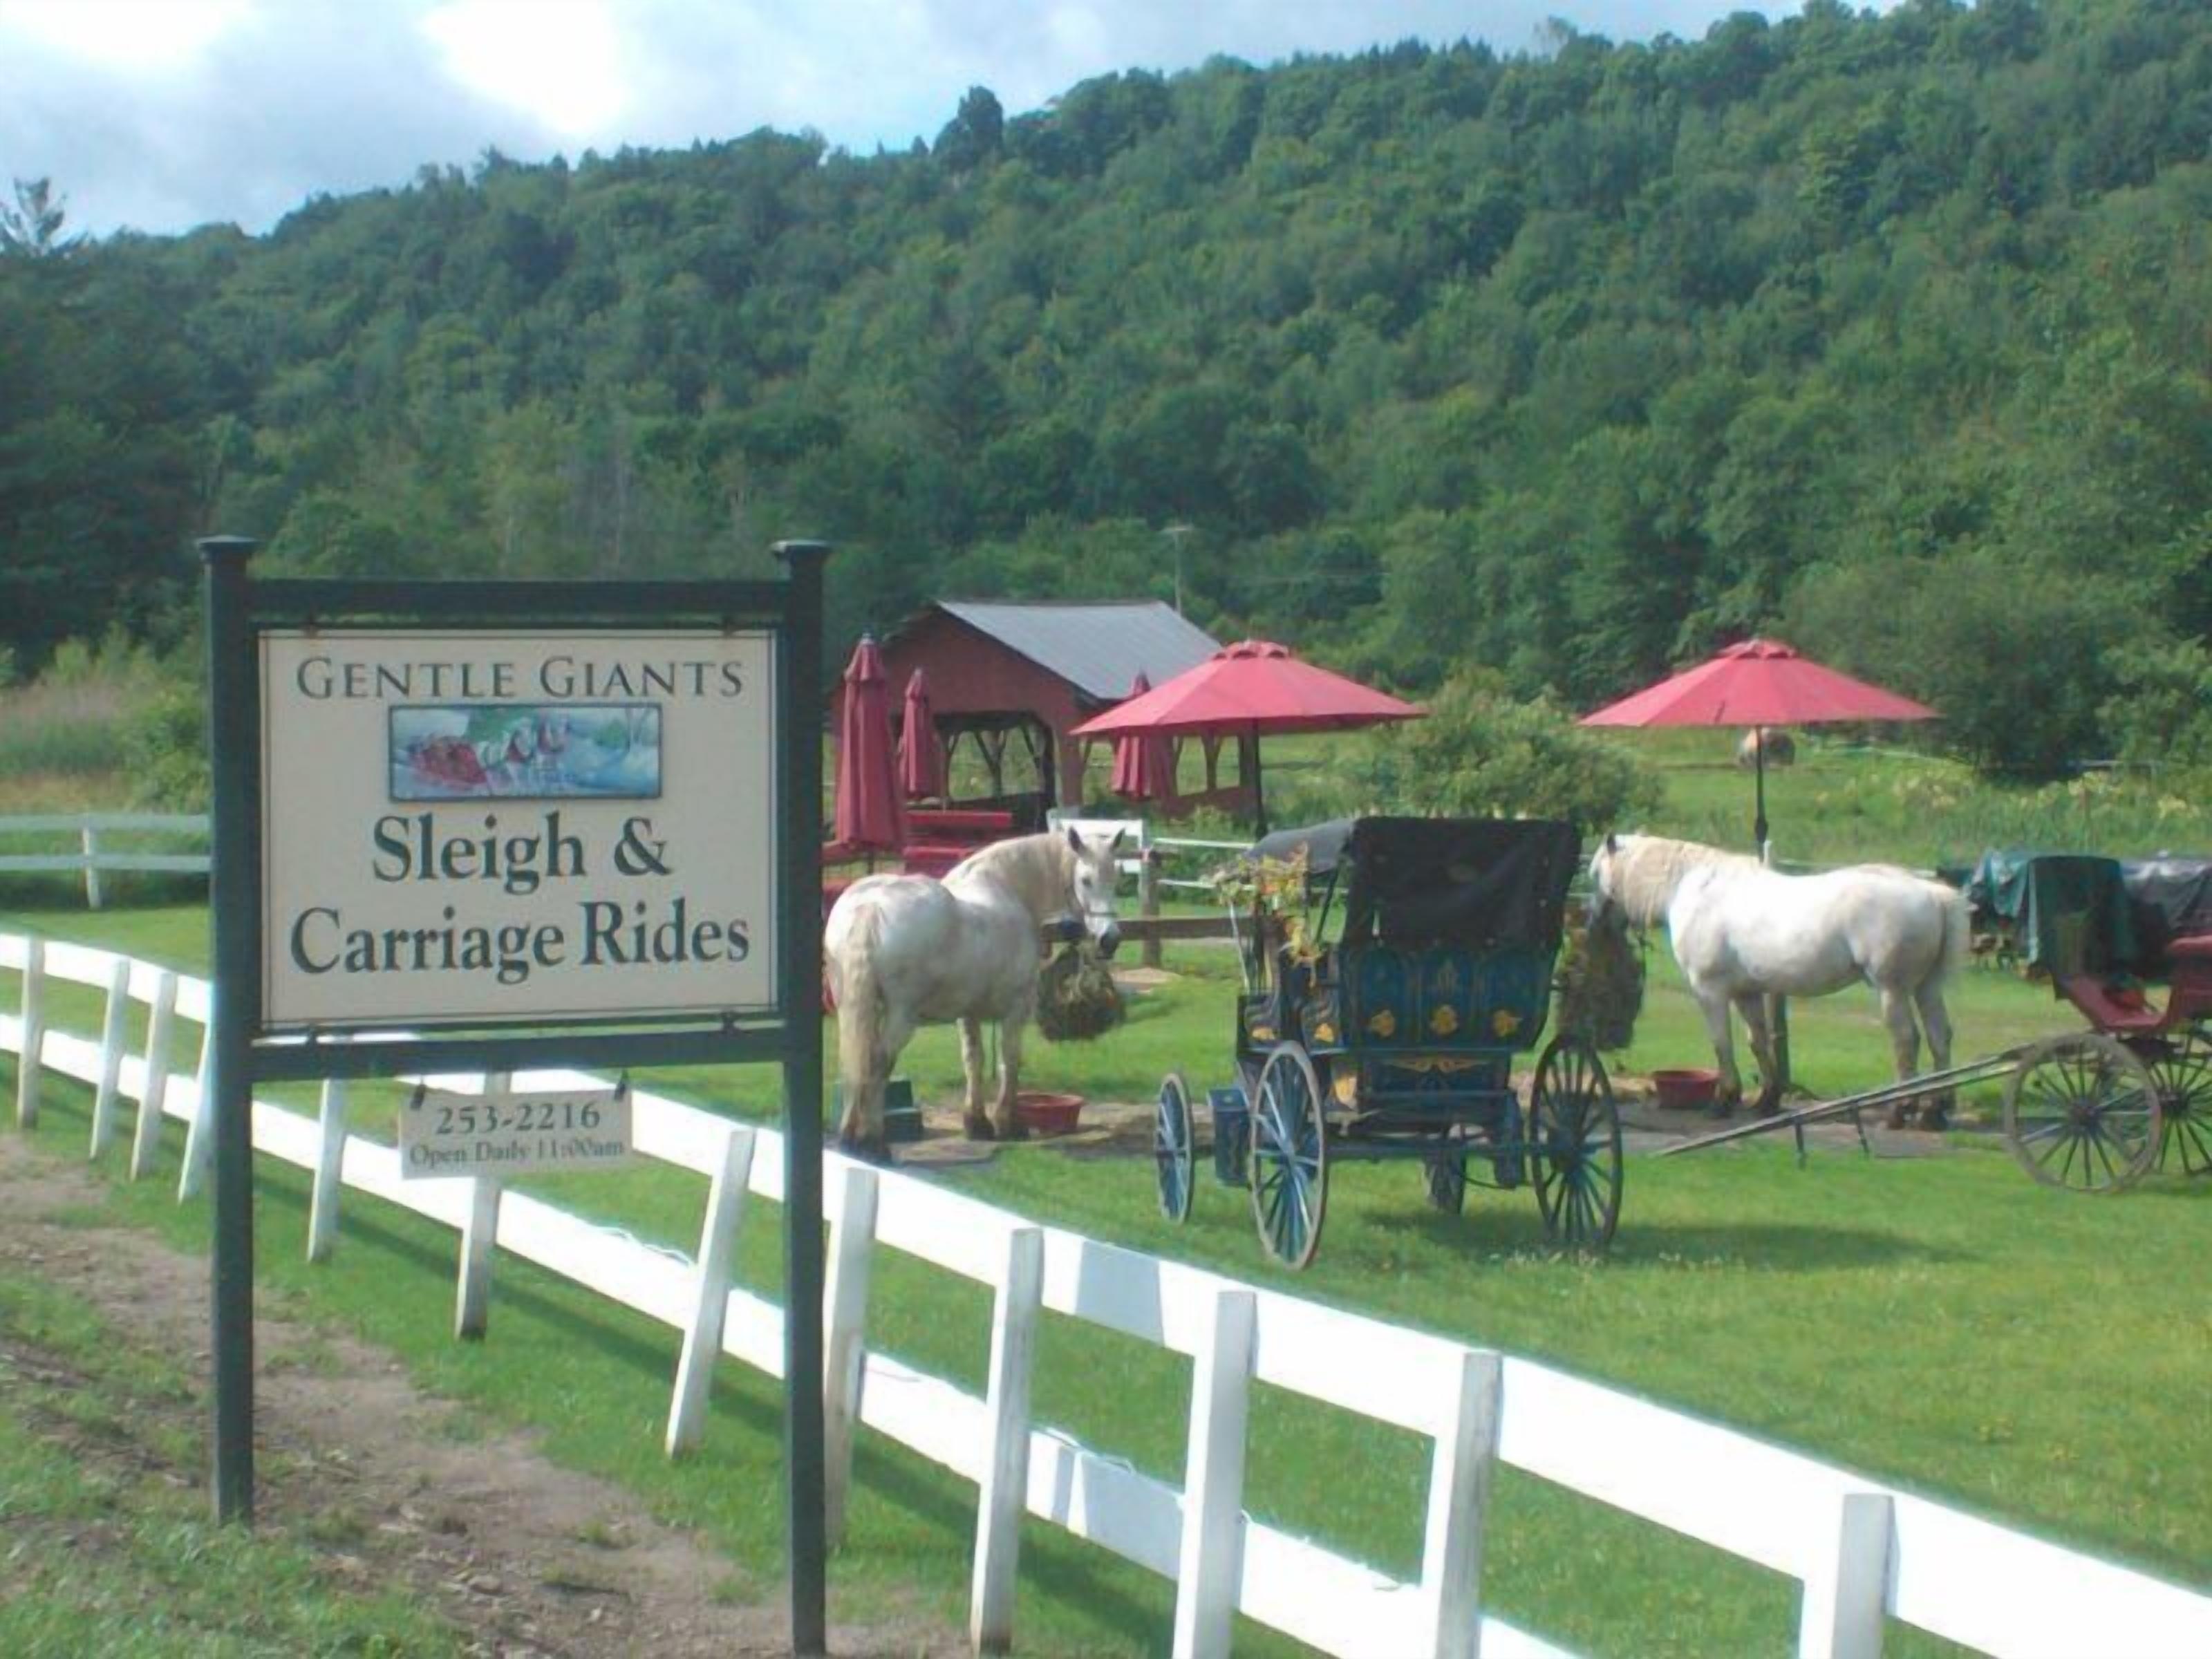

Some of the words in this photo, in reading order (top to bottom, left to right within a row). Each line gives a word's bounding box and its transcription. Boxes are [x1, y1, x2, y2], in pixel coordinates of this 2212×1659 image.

[297, 655, 514, 700] GENTLE
[539, 655, 743, 697] GIANTS
[372, 812, 586, 896] Sleigh
[613, 816, 673, 877] &
[290, 906, 564, 986] Carriage
[579, 897, 750, 966] Rides
[435, 1102, 600, 1135] 253-2216
[409, 1144, 466, 1168] Open
[475, 1141, 531, 1165] Daily
